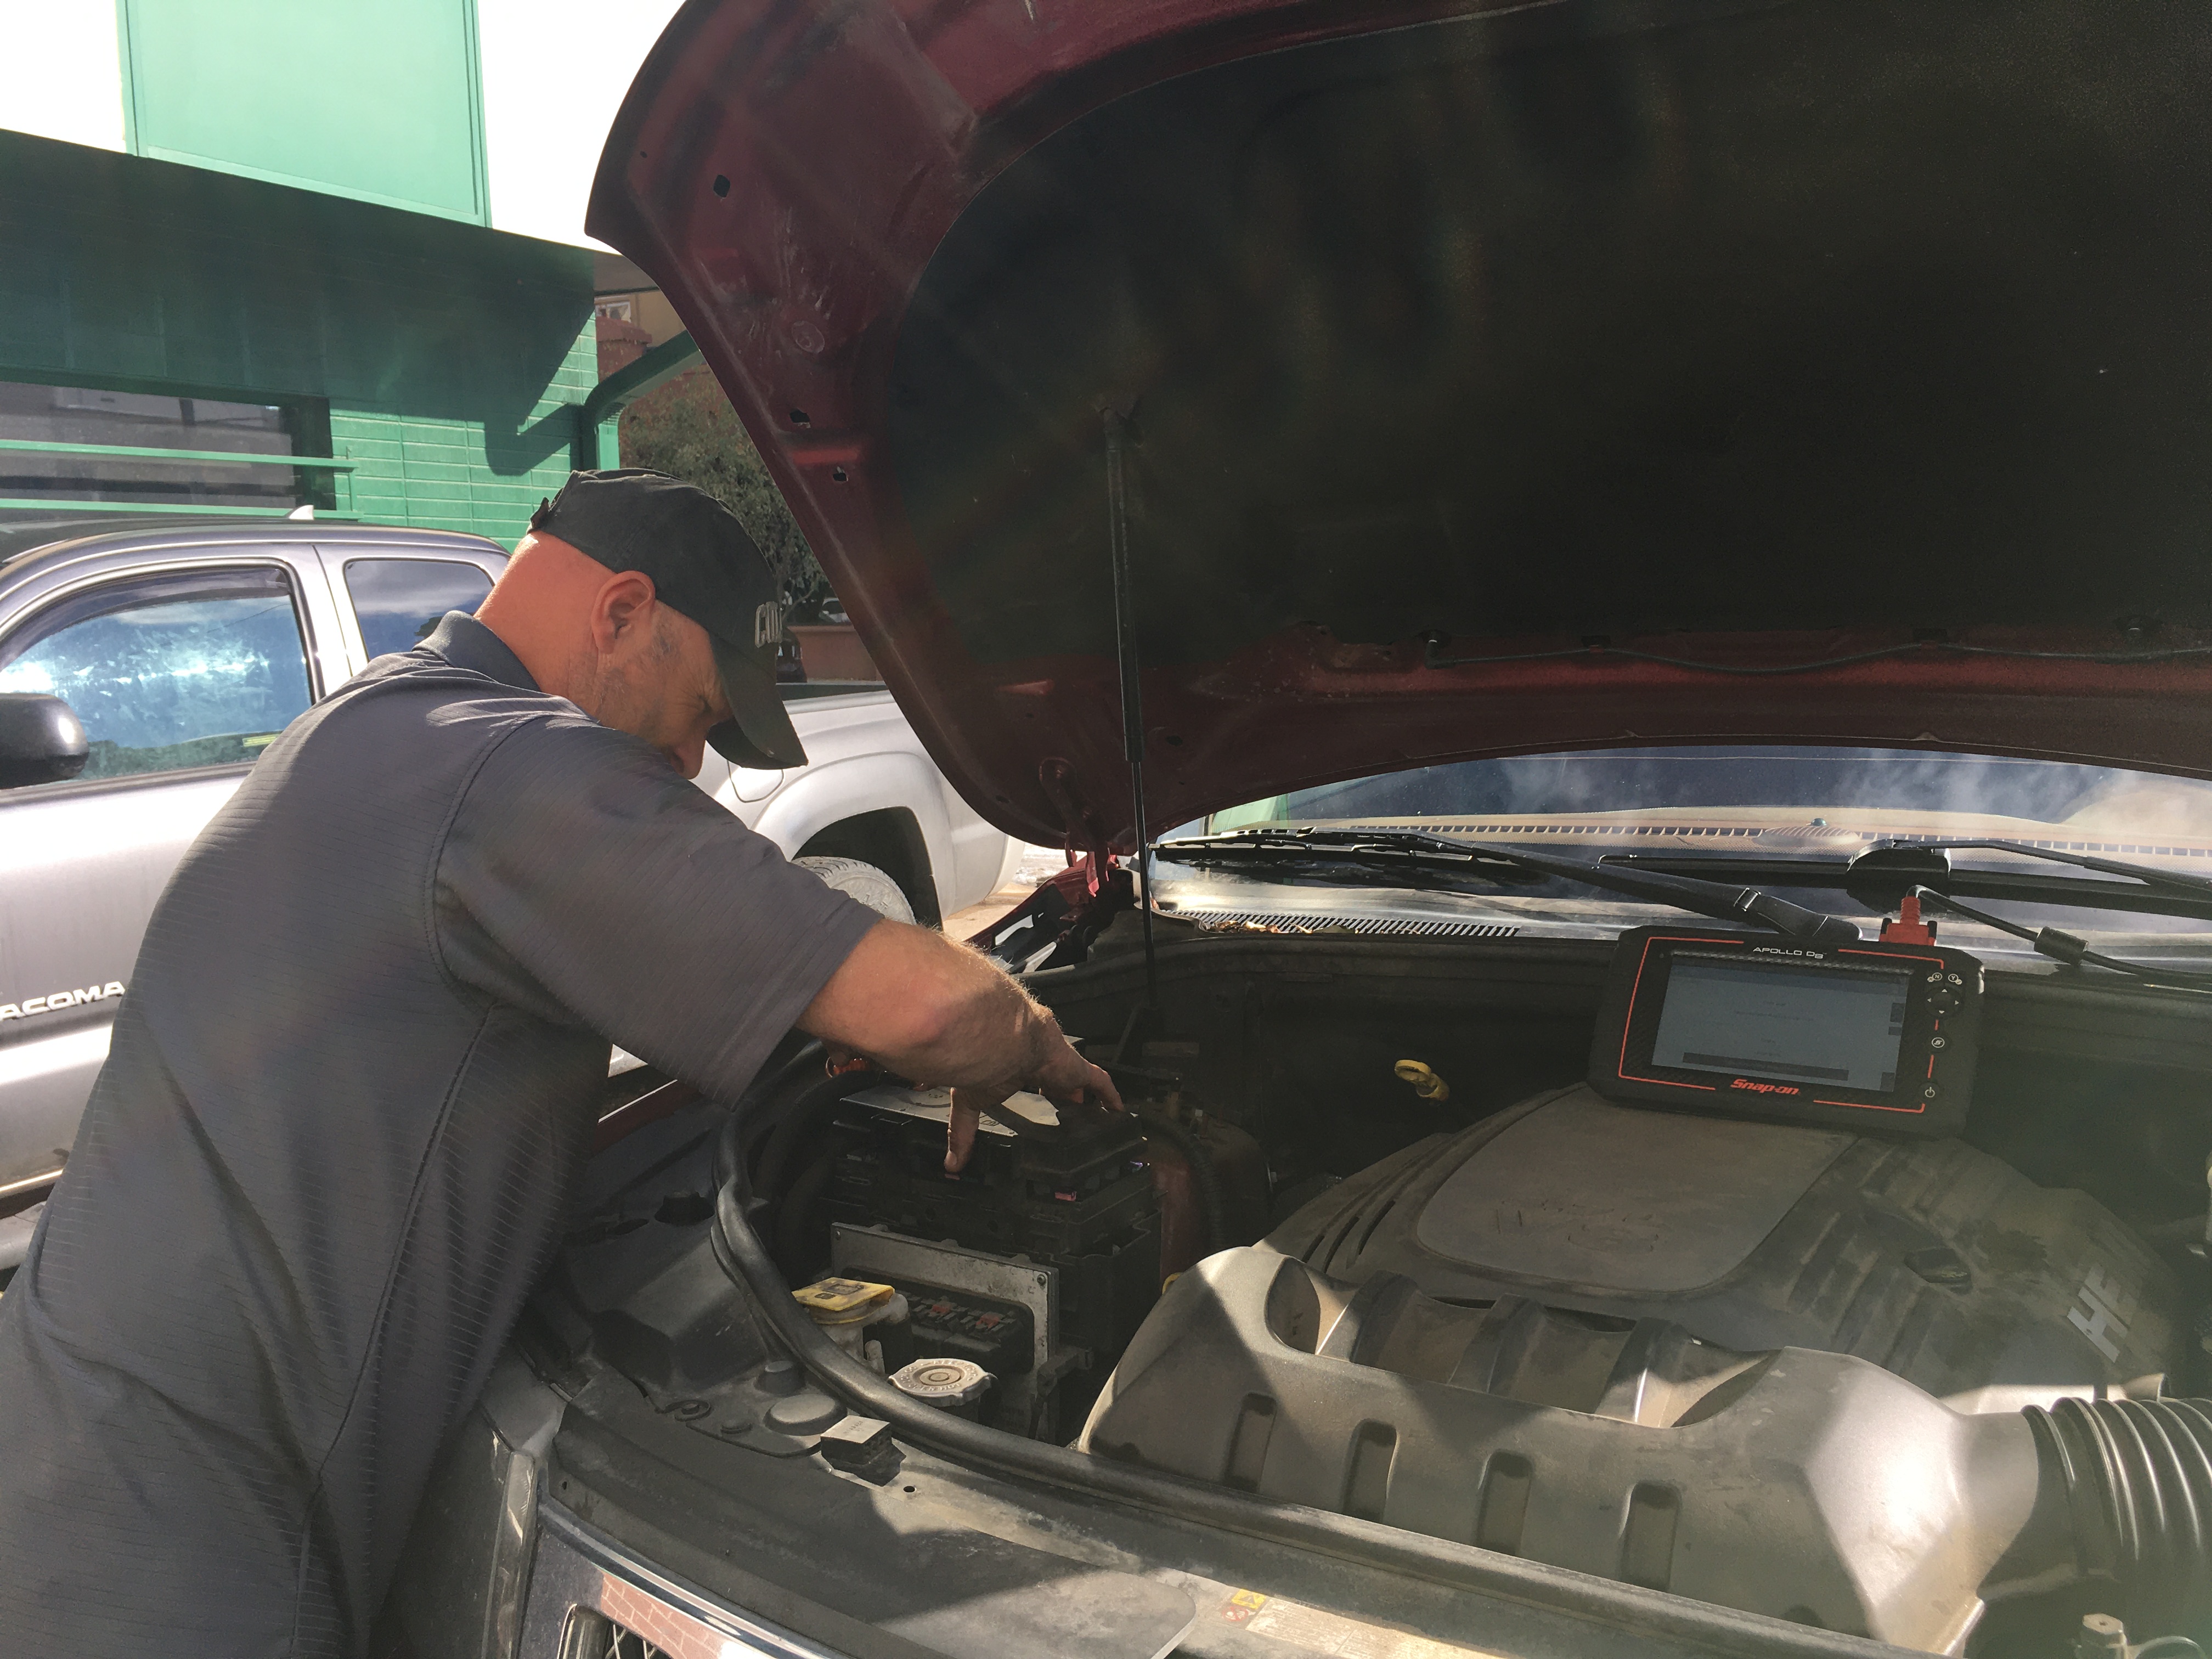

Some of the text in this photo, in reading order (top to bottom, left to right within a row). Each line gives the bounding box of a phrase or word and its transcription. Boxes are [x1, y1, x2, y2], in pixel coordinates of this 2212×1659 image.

[1753, 947, 1803, 956] APOLLO
[0, 981, 126, 1021] ACOMA
[1730, 1079, 1799, 1095] Snap-on
